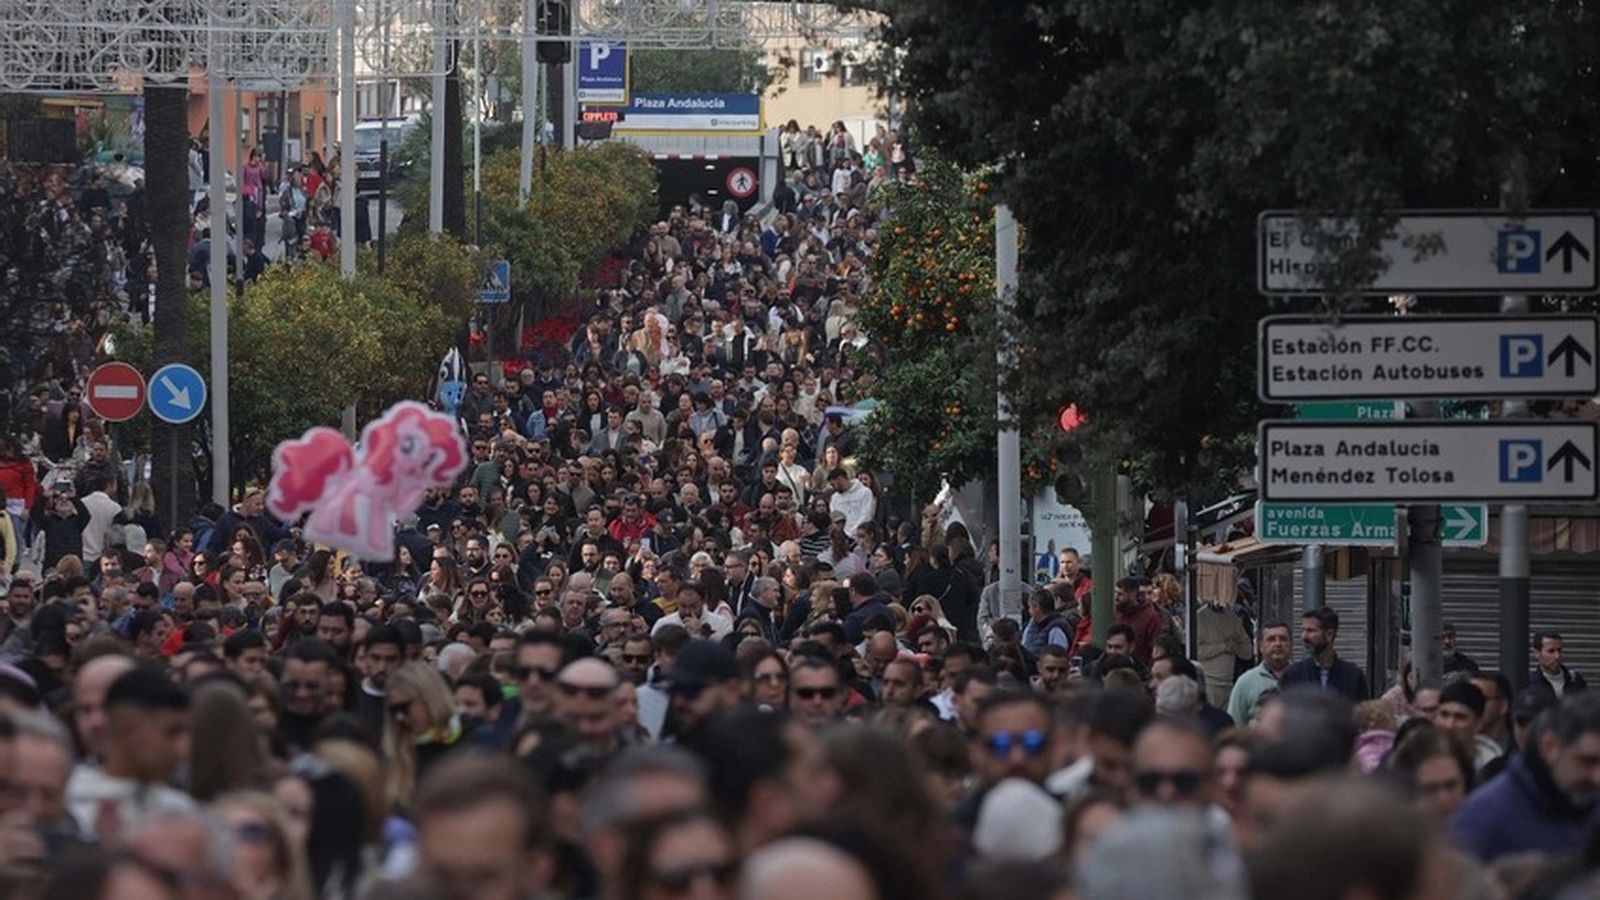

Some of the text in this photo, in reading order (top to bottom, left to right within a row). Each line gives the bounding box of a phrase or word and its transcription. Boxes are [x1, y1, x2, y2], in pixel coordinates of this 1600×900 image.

[590, 42, 610, 70] P
[634, 97, 725, 108] Plaza Andalucía
[582, 112, 618, 122] COMPLETO
[1507, 234, 1535, 270] P
[1272, 336, 1439, 355] Estación FF.CC.
[1509, 339, 1537, 375] P
[1272, 363, 1484, 382] Estación Autobuses
[1271, 439, 1440, 457] Plaza Andalucía
[1508, 444, 1535, 480] P
[1271, 467, 1455, 484] Menéndez Tolosa
[1267, 507, 1324, 519] avenida
[1267, 522, 1341, 537] Fuerzas
